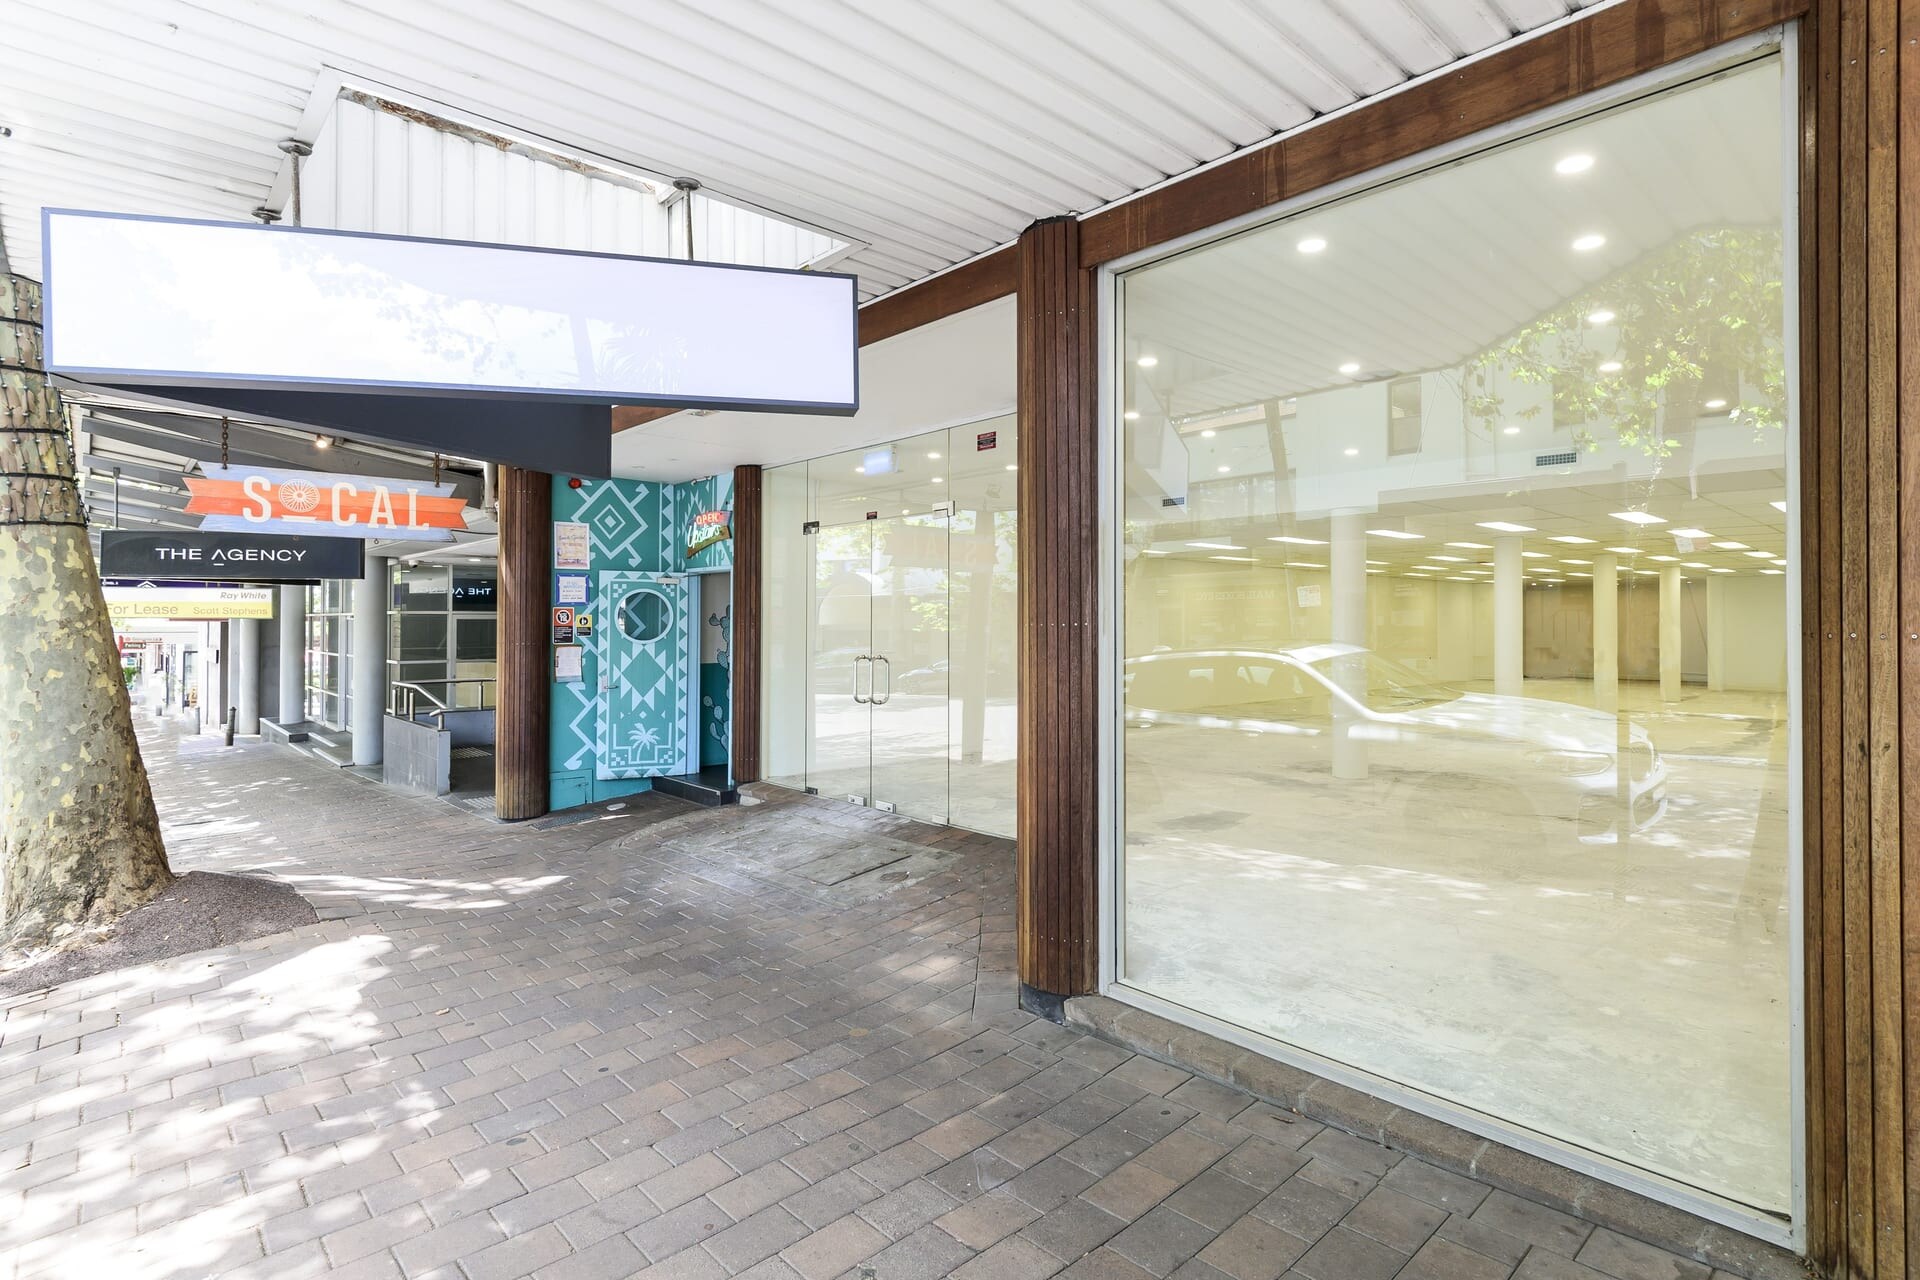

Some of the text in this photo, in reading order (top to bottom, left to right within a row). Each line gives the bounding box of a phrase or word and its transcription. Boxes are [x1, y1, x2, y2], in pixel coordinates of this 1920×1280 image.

[155, 547, 307, 565] THE AGENCY
[220, 591, 267, 602] Ray White
[134, 603, 178, 615] Lease
[193, 606, 268, 617] Scott Stephens
